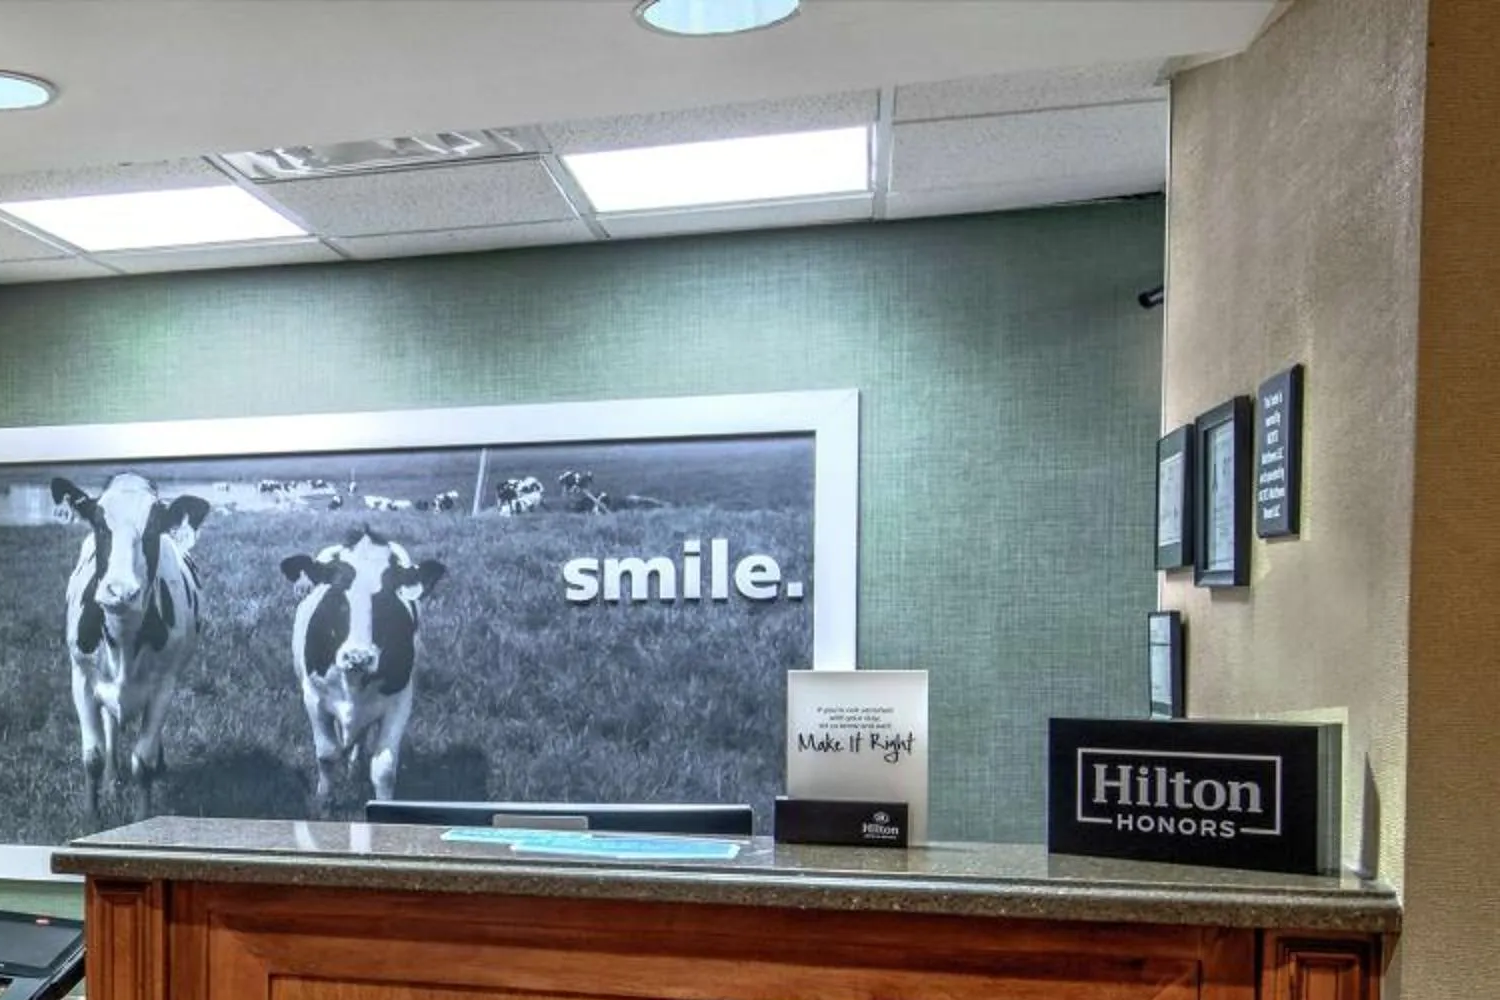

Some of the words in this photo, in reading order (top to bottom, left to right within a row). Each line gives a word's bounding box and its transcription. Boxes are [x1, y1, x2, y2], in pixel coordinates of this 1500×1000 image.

[563, 538, 803, 602] smile.
[797, 732, 844, 752] Make
[849, 731, 863, 752] It
[870, 731, 916, 764] Right
[1092, 763, 1264, 814] Hilton
[1116, 813, 1236, 838] HONORS
